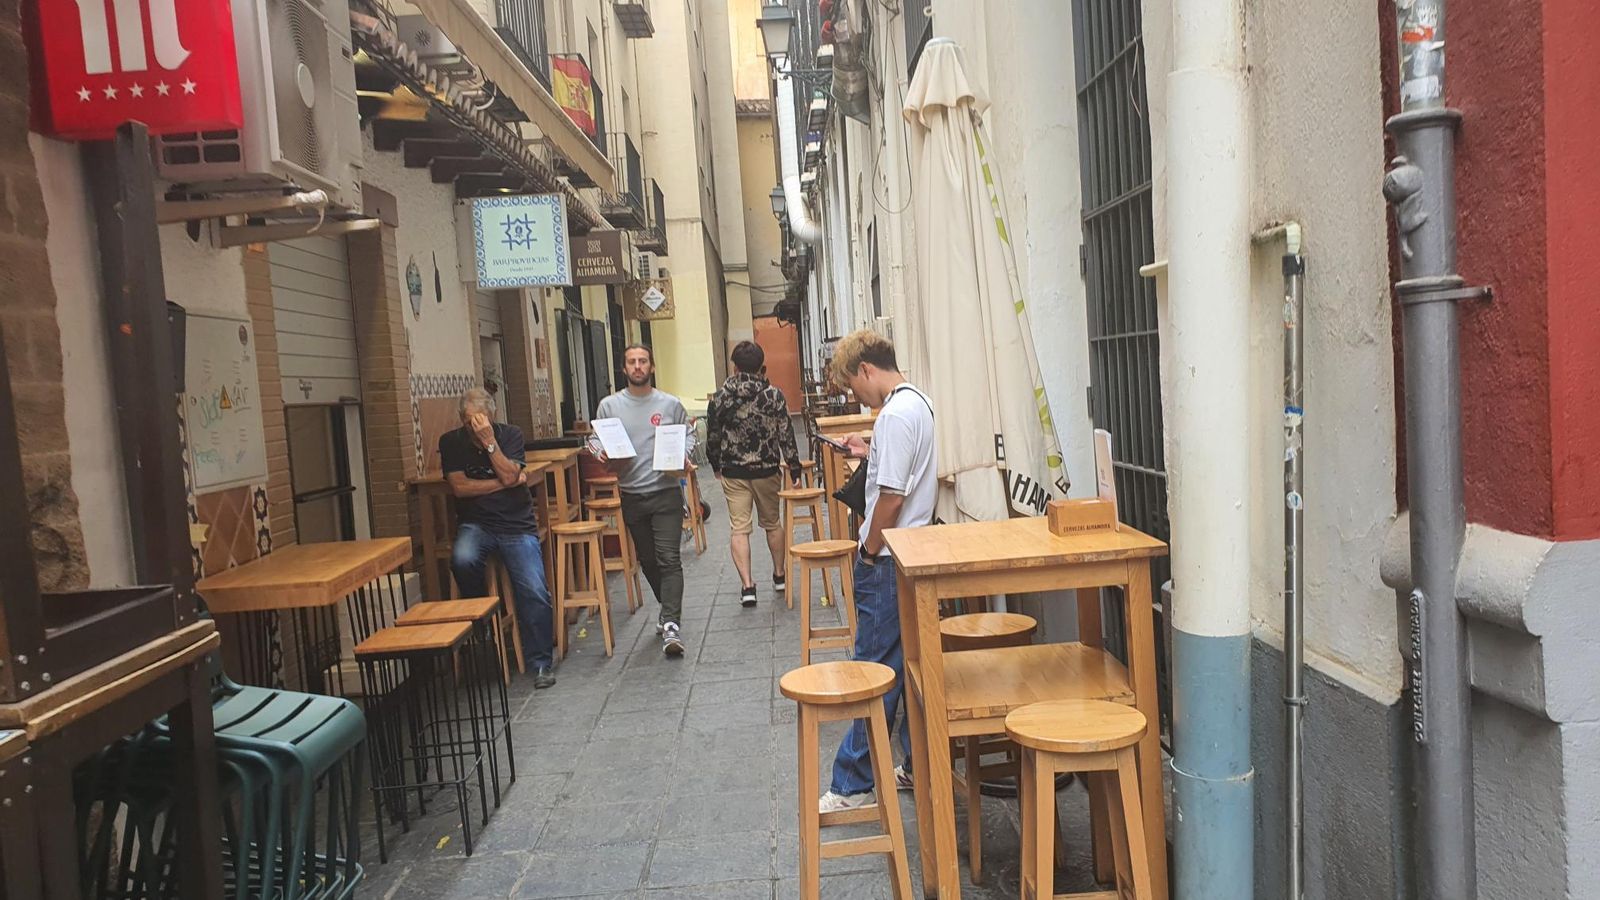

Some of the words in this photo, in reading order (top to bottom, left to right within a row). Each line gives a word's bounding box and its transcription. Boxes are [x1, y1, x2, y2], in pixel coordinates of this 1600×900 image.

[577, 256, 614, 267] CERVEZAS
[576, 266, 617, 277] ALHAMBRA
[1063, 525, 1085, 533] CERVEZAS
[1409, 592, 1421, 660] GRANADA
[1412, 669, 1424, 743] GONZALEZ
